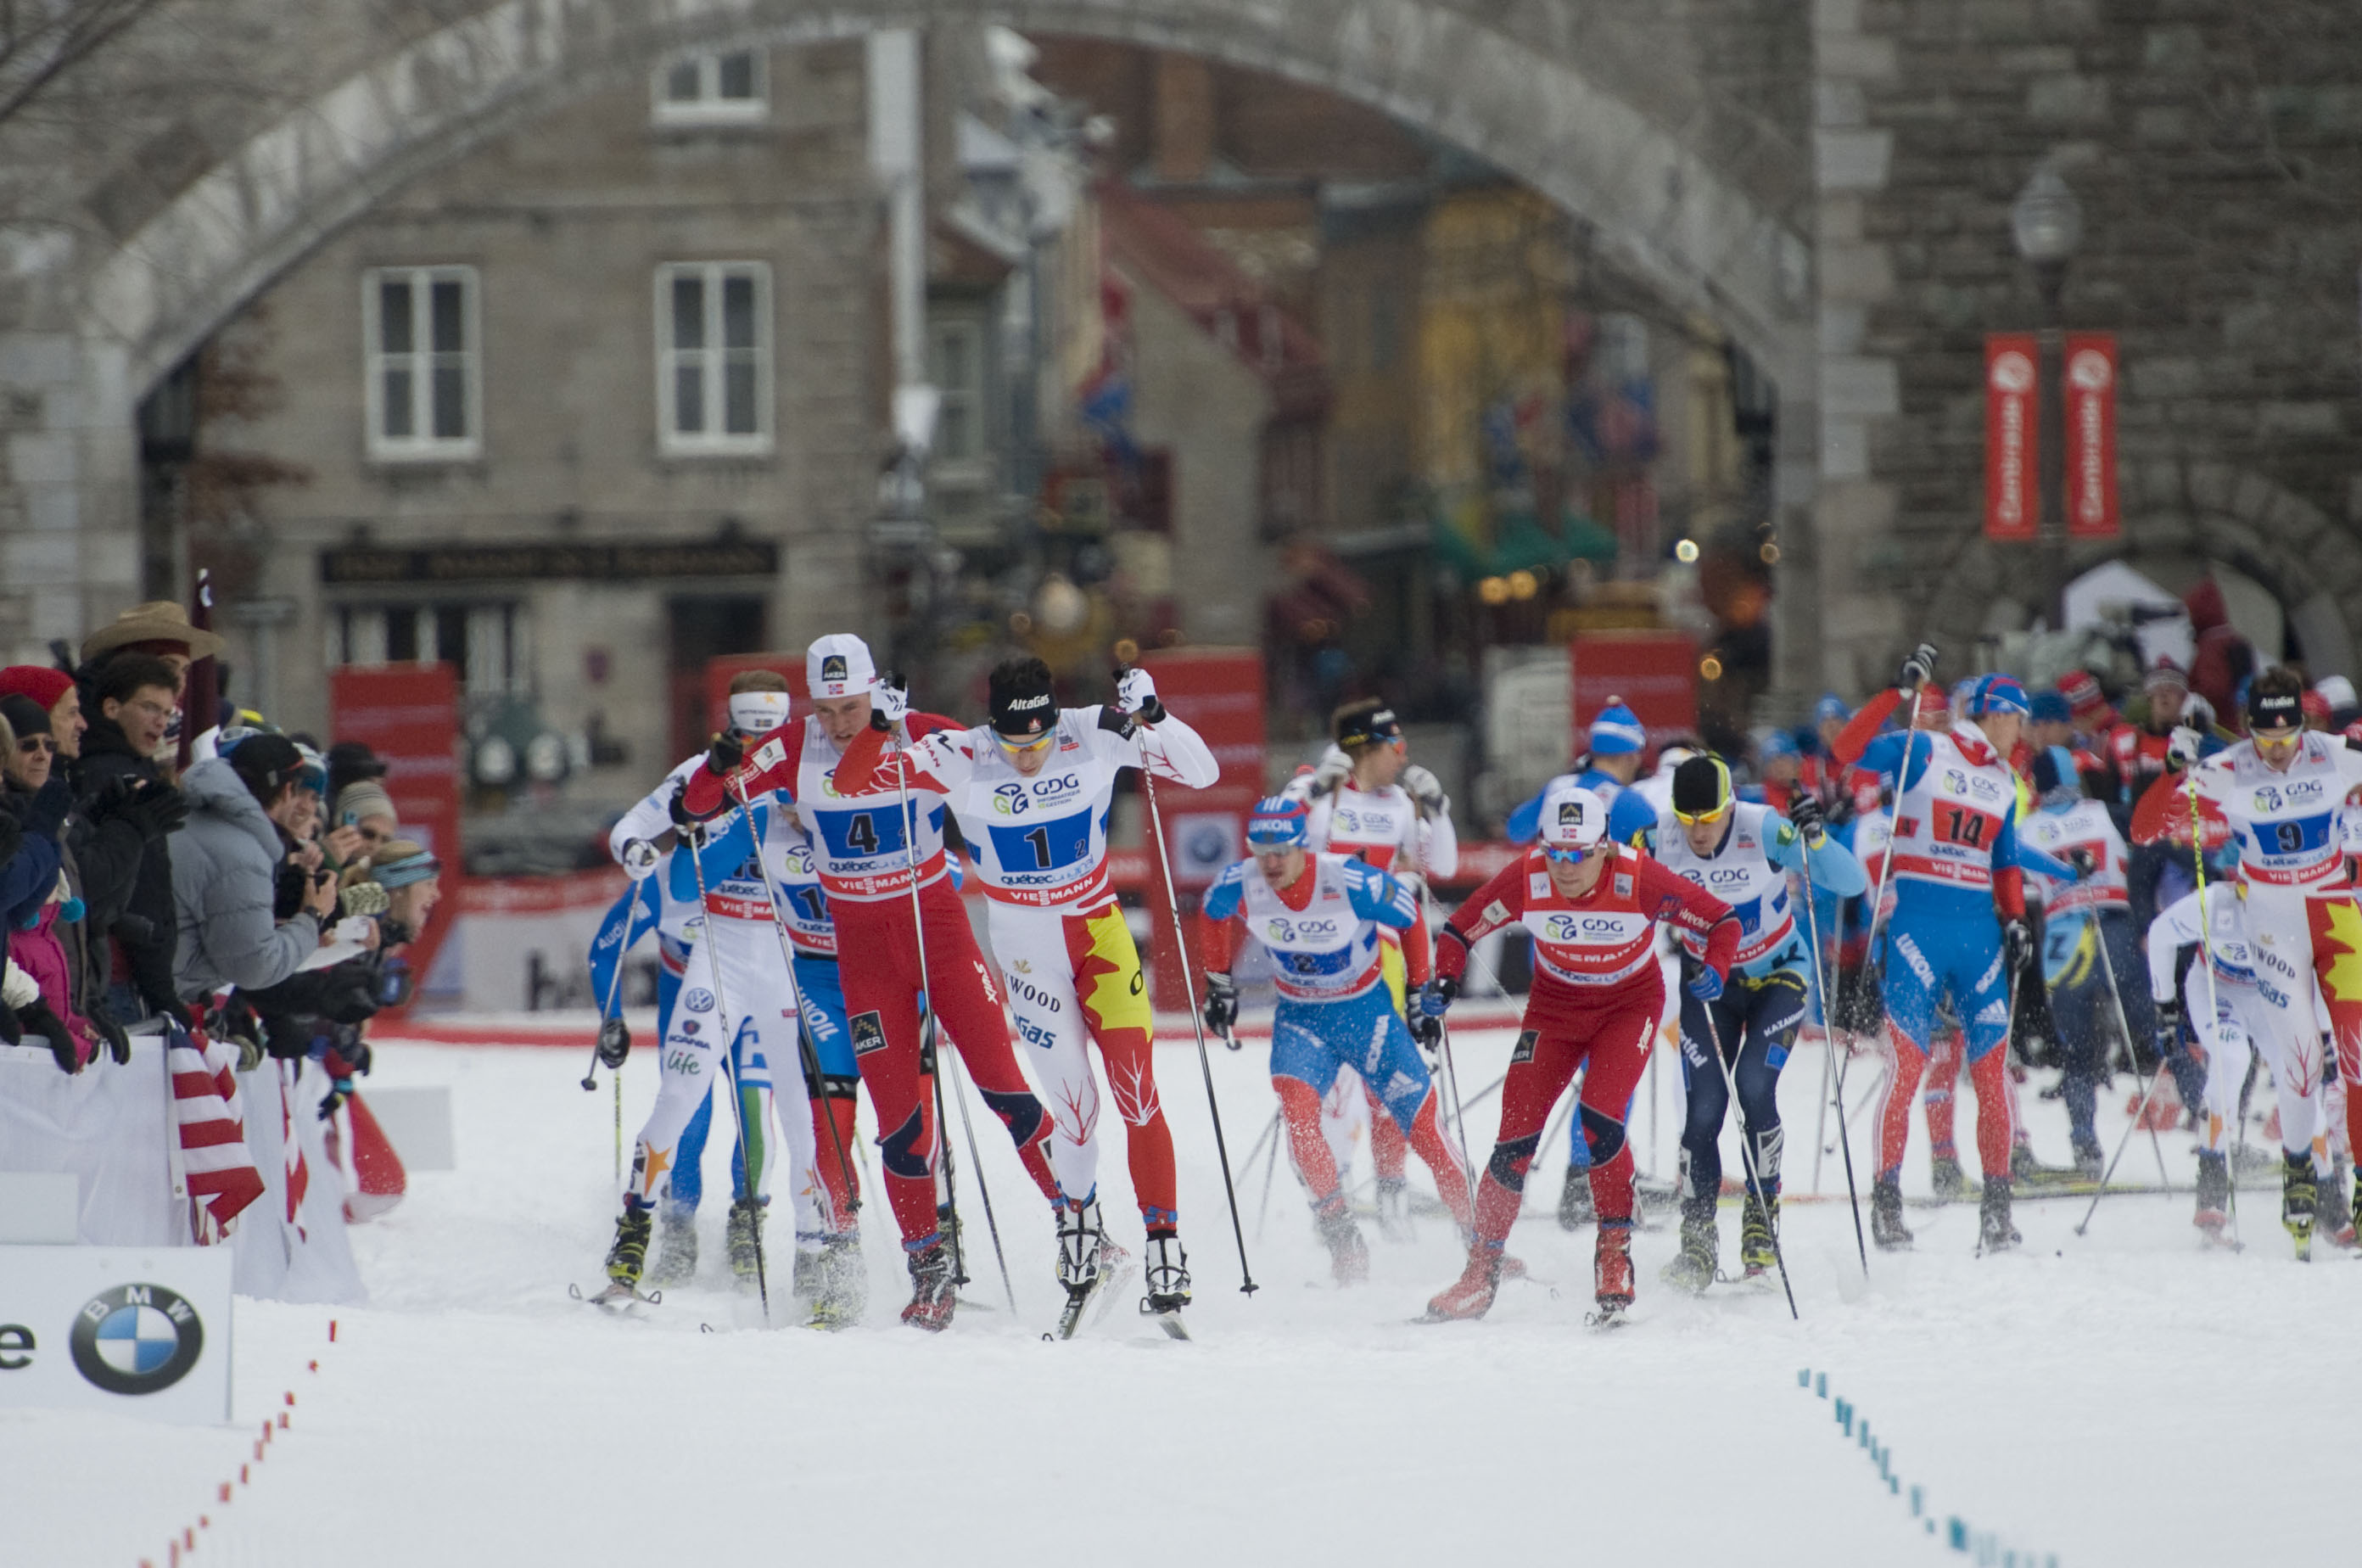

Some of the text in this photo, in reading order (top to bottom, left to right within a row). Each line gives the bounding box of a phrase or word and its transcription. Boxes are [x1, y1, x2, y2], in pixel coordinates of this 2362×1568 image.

[1008, 693, 1049, 711] AltaGas
[1033, 774, 1079, 796] GDG
[1560, 815, 1581, 824] AKER
[1948, 808, 1984, 848] 14
[847, 812, 880, 854] 4
[2276, 821, 2303, 853] 9
[1024, 826, 1052, 869] 1
[1074, 838, 1086, 859] 2
[828, 861, 876, 873] québec
[1710, 869, 1749, 883] GDG
[1001, 875, 1053, 886] québec
[1010, 876, 1094, 906] VIESSMANN
[719, 900, 772, 918] VIESSMA
[1298, 920, 1337, 933] GDG
[1582, 919, 1623, 932] GDG
[1895, 932, 1936, 989] LUKOIL
[973, 960, 999, 1005] Swix
[668, 1033, 711, 1050] SCANIA
[855, 1035, 882, 1051] AKER
[1637, 1016, 1654, 1056] Swix
[667, 1049, 701, 1075] life
[85, 1285, 194, 1325] BMW
